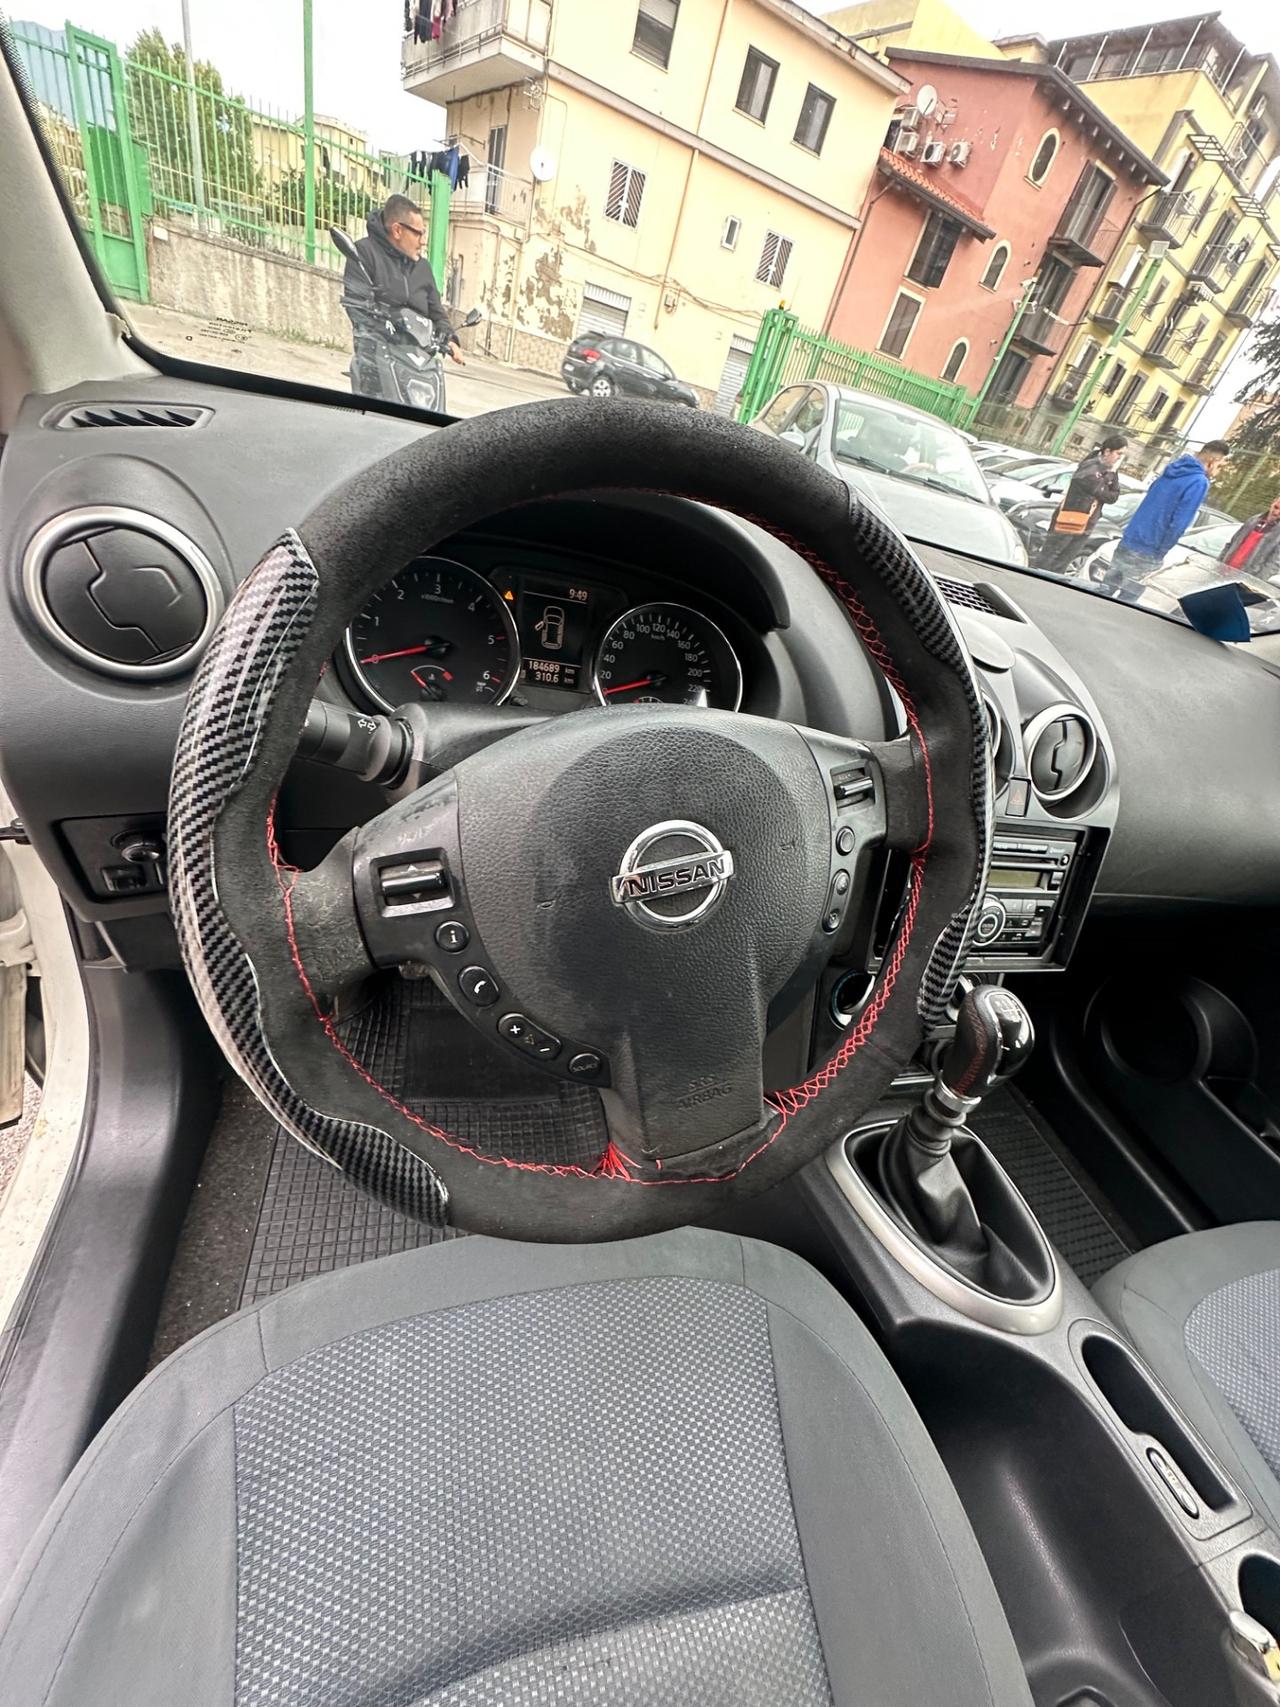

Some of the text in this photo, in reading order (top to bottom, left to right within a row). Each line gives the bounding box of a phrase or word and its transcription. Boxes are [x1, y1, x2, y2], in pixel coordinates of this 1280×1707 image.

[435, 584, 441, 594] 3
[397, 590, 404, 600] 2
[468, 602, 475, 612] 4
[636, 624, 651, 634] 100
[652, 623, 666, 633] 120
[623, 630, 636, 640] 80
[667, 629, 680, 639] 140
[488, 635, 495, 645] 5
[677, 640, 691, 650] 160
[612, 641, 624, 650] 60
[603, 654, 616, 663] 40
[684, 653, 698, 662] 180
[529, 660, 560, 673] 184689
[483, 670, 490, 680] 6
[535, 671, 559, 683] 310.6
[600, 670, 612, 679] 20
[687, 668, 703, 677] 200
[627, 858, 725, 897] NISSAN
